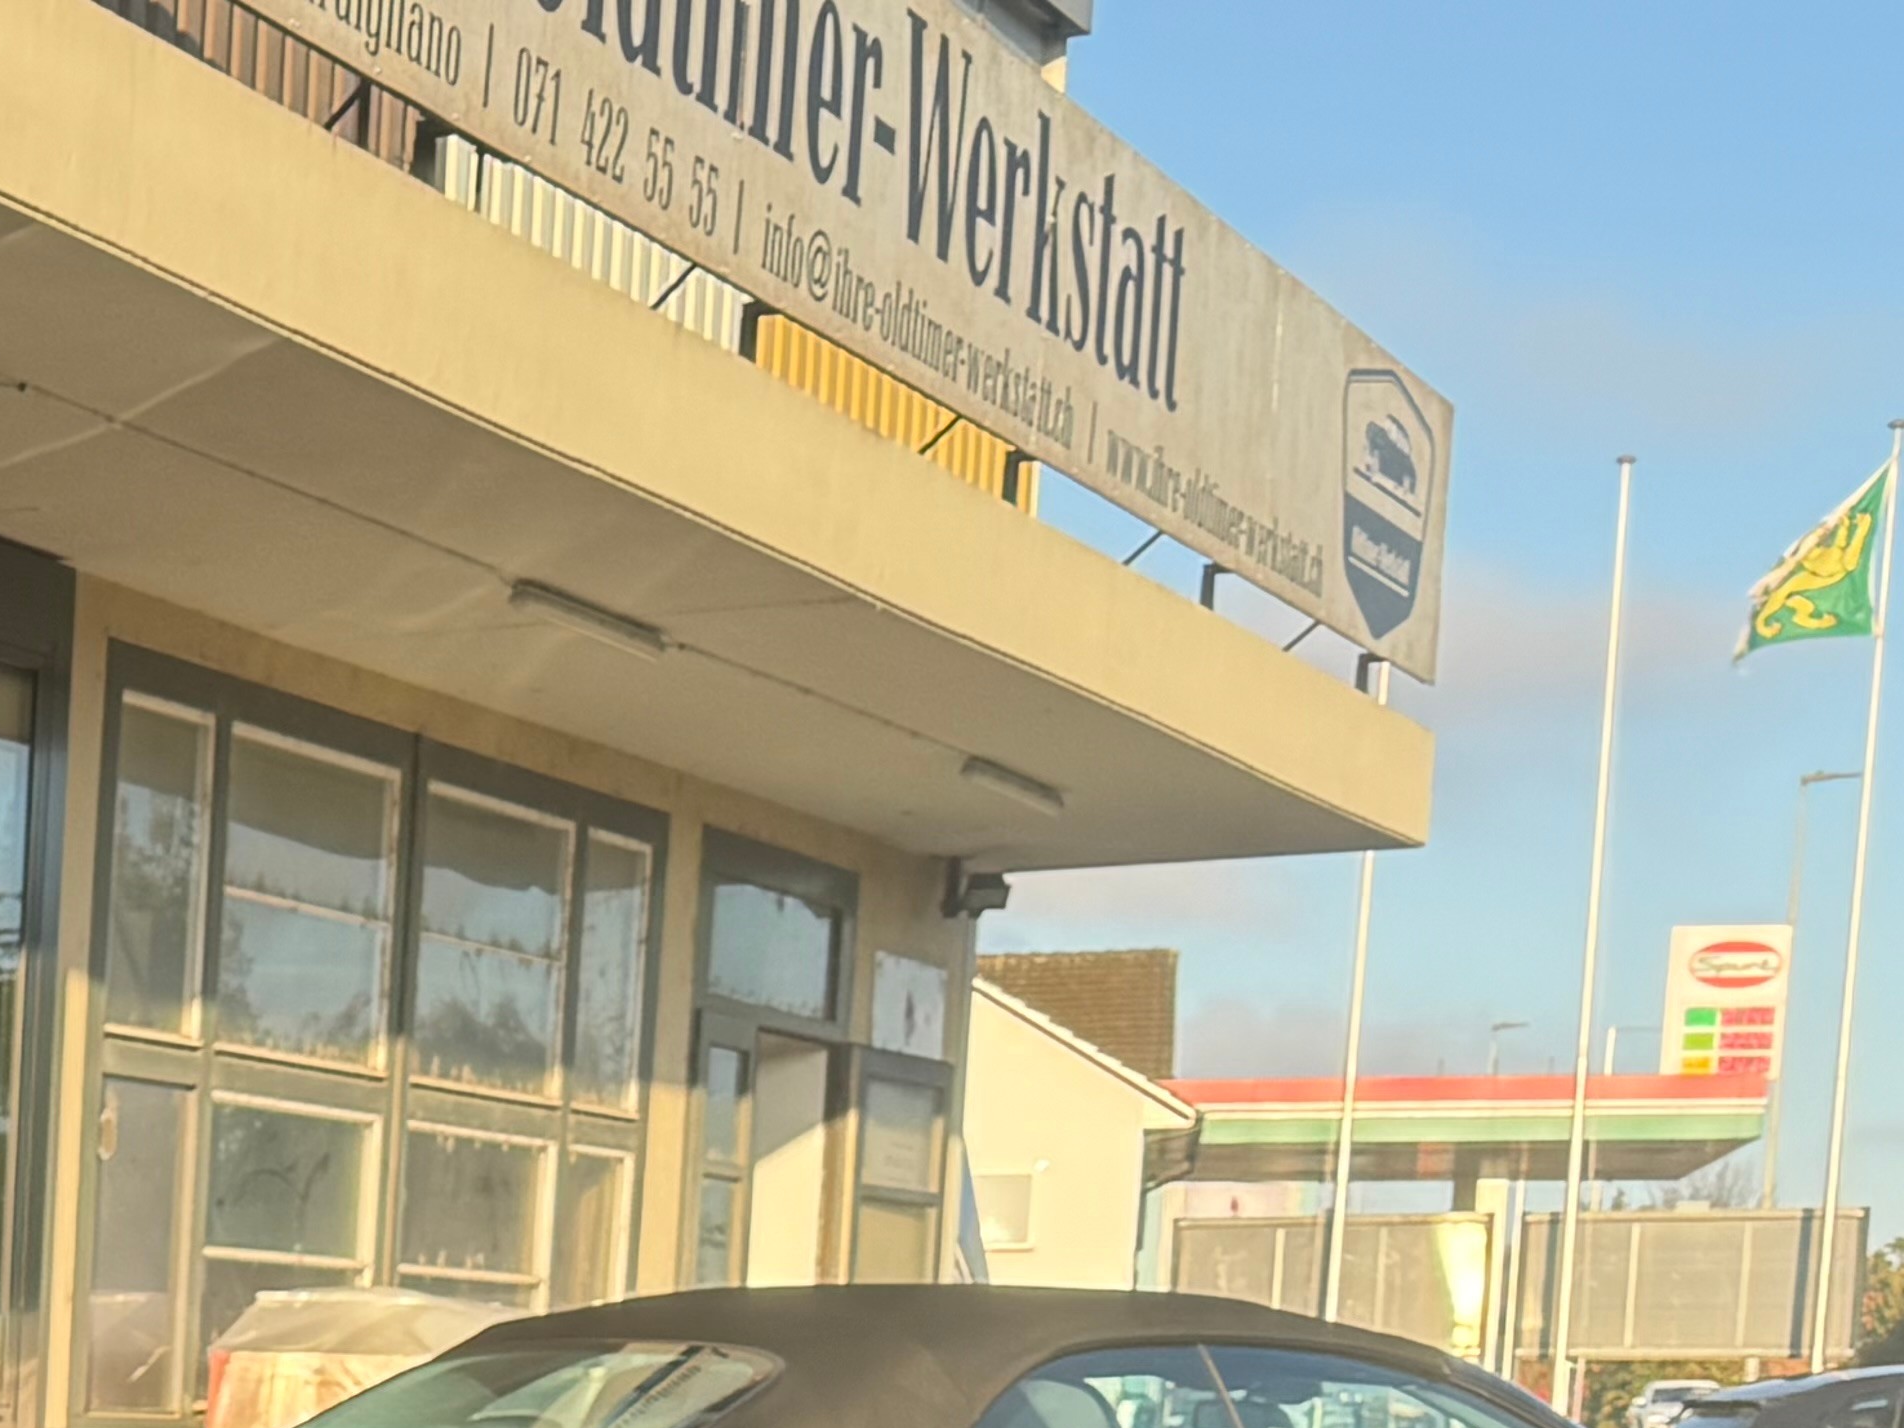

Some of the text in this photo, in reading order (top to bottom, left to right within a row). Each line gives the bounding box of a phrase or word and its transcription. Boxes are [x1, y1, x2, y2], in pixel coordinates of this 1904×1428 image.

[513, 47, 562, 146] 071
[581, 88, 629, 184] 422
[643, 127, 674, 211] 55
[689, 155, 719, 237] 55
